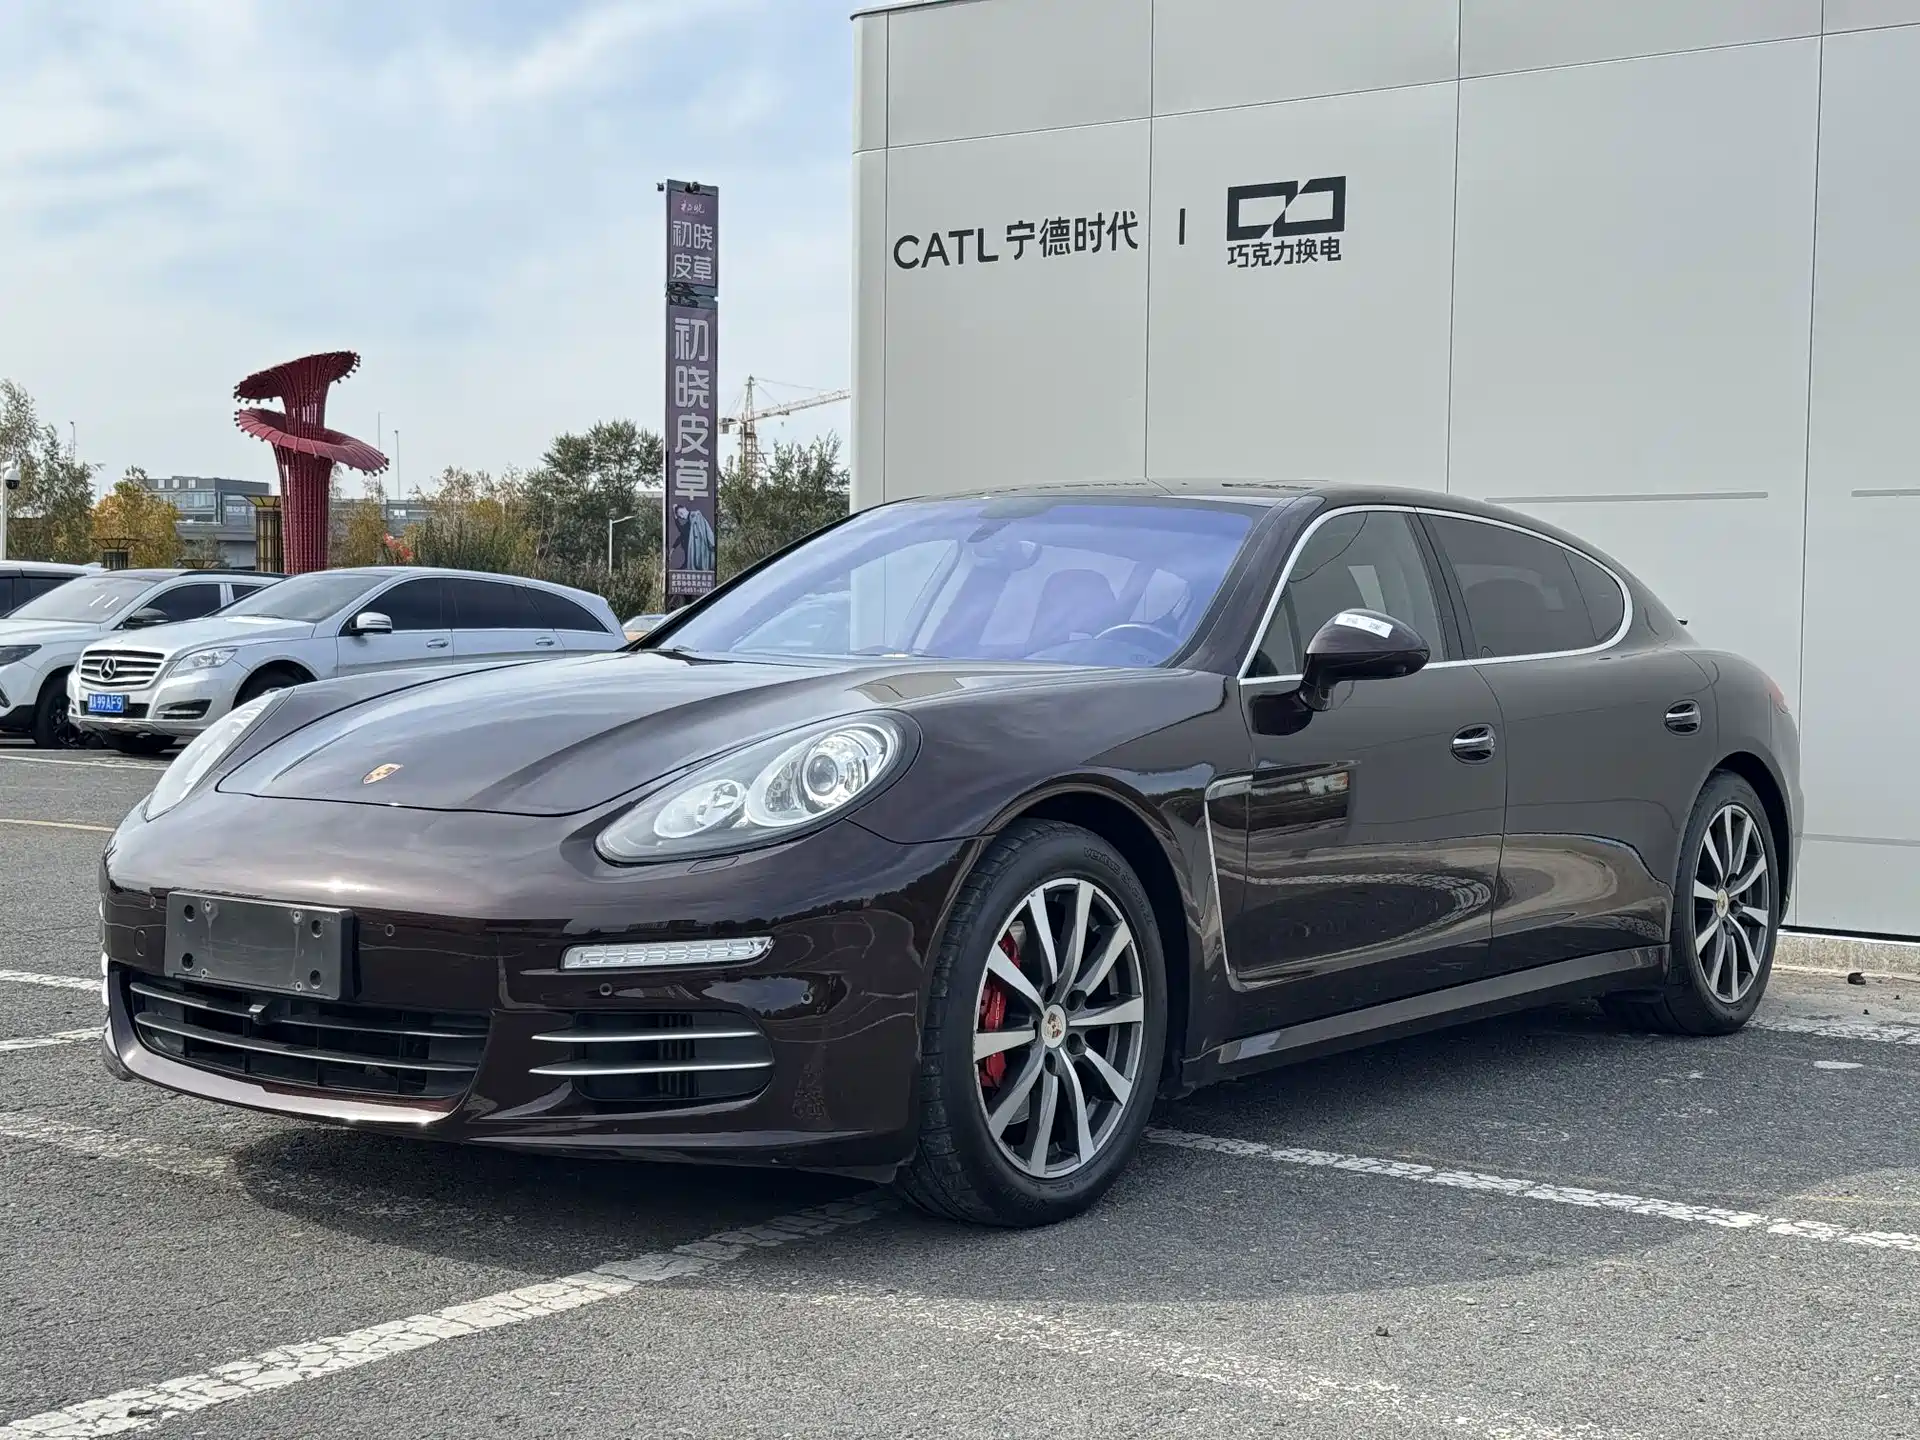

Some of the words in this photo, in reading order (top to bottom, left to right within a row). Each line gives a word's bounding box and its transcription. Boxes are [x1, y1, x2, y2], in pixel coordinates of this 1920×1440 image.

[672, 220, 713, 251] 初晓
[893, 228, 999, 270] CATL
[1006, 210, 1139, 261] 宁德时代
[672, 252, 713, 281] 皮草
[1227, 236, 1342, 268] 巧克力换电
[674, 316, 710, 501] 初晓皮草
